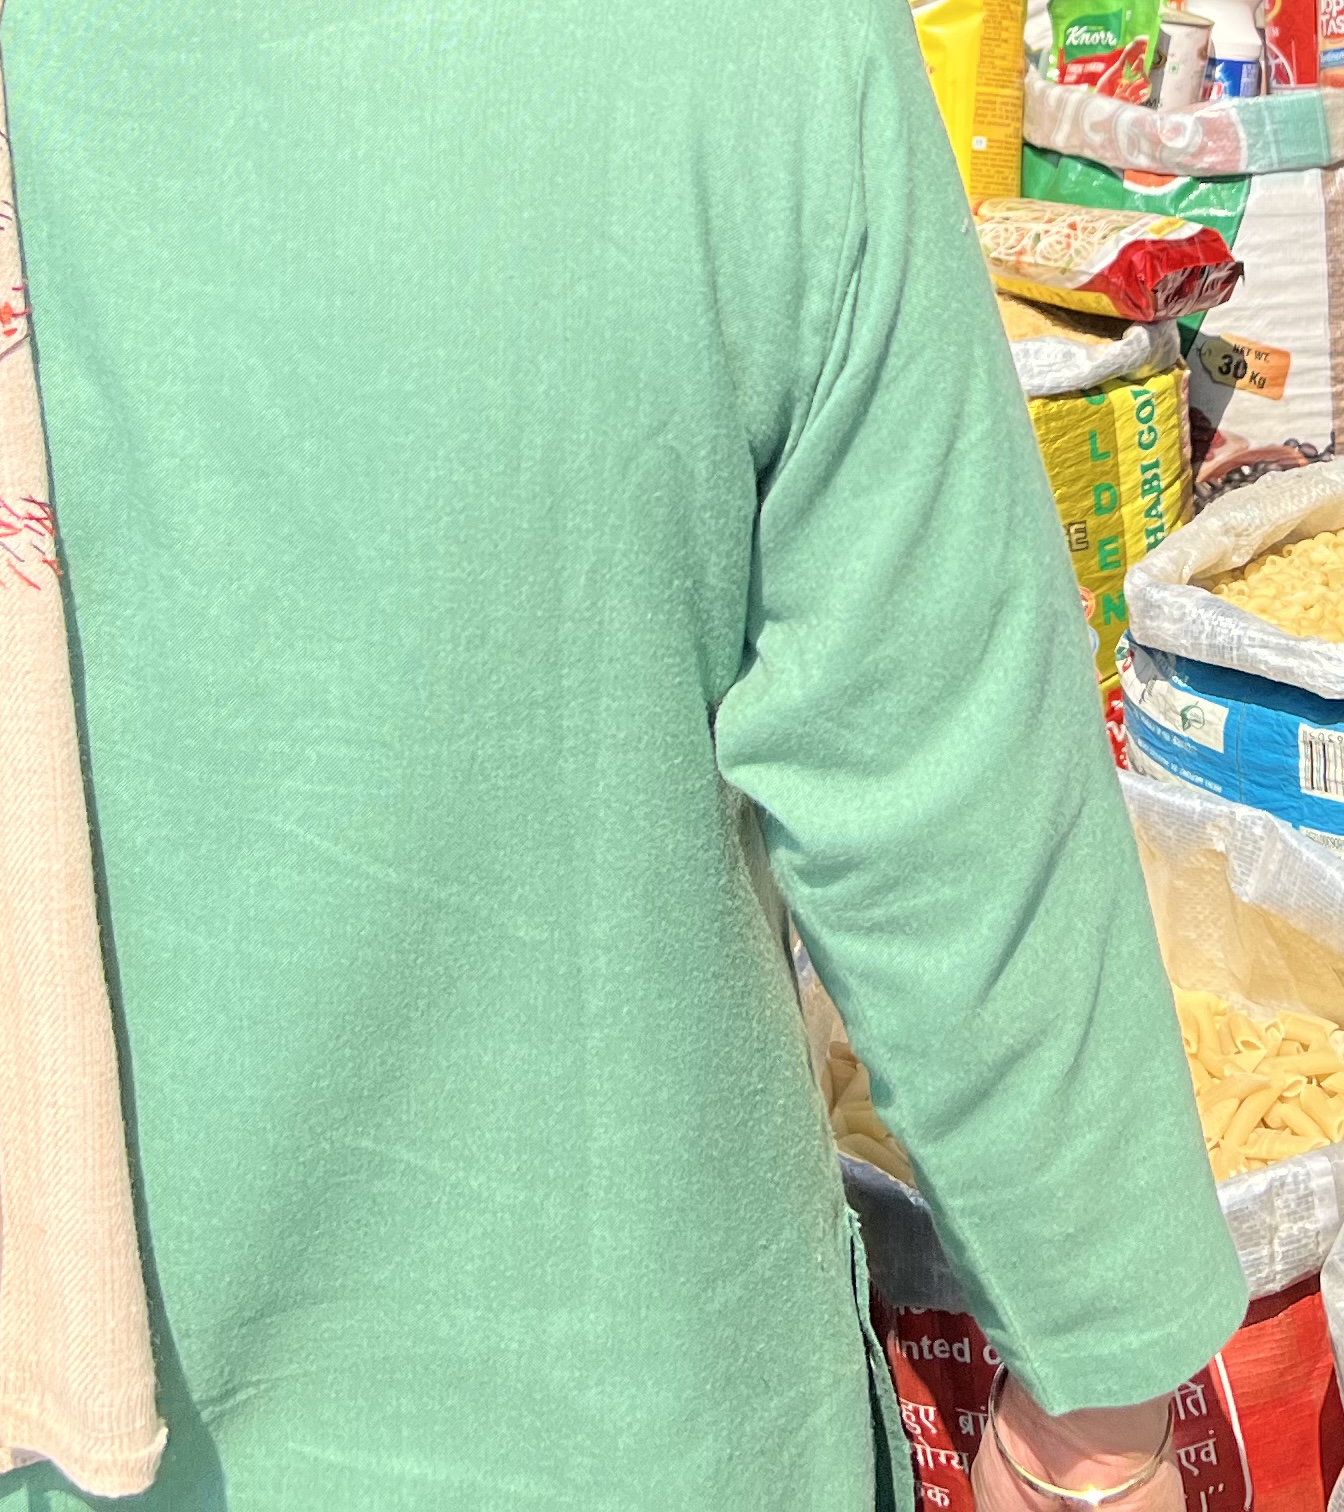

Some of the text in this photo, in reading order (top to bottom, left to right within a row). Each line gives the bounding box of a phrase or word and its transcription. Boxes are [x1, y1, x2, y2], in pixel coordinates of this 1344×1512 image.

[1065, 25, 1118, 47] Knorr
[1218, 353, 1267, 390] 30 Kg
